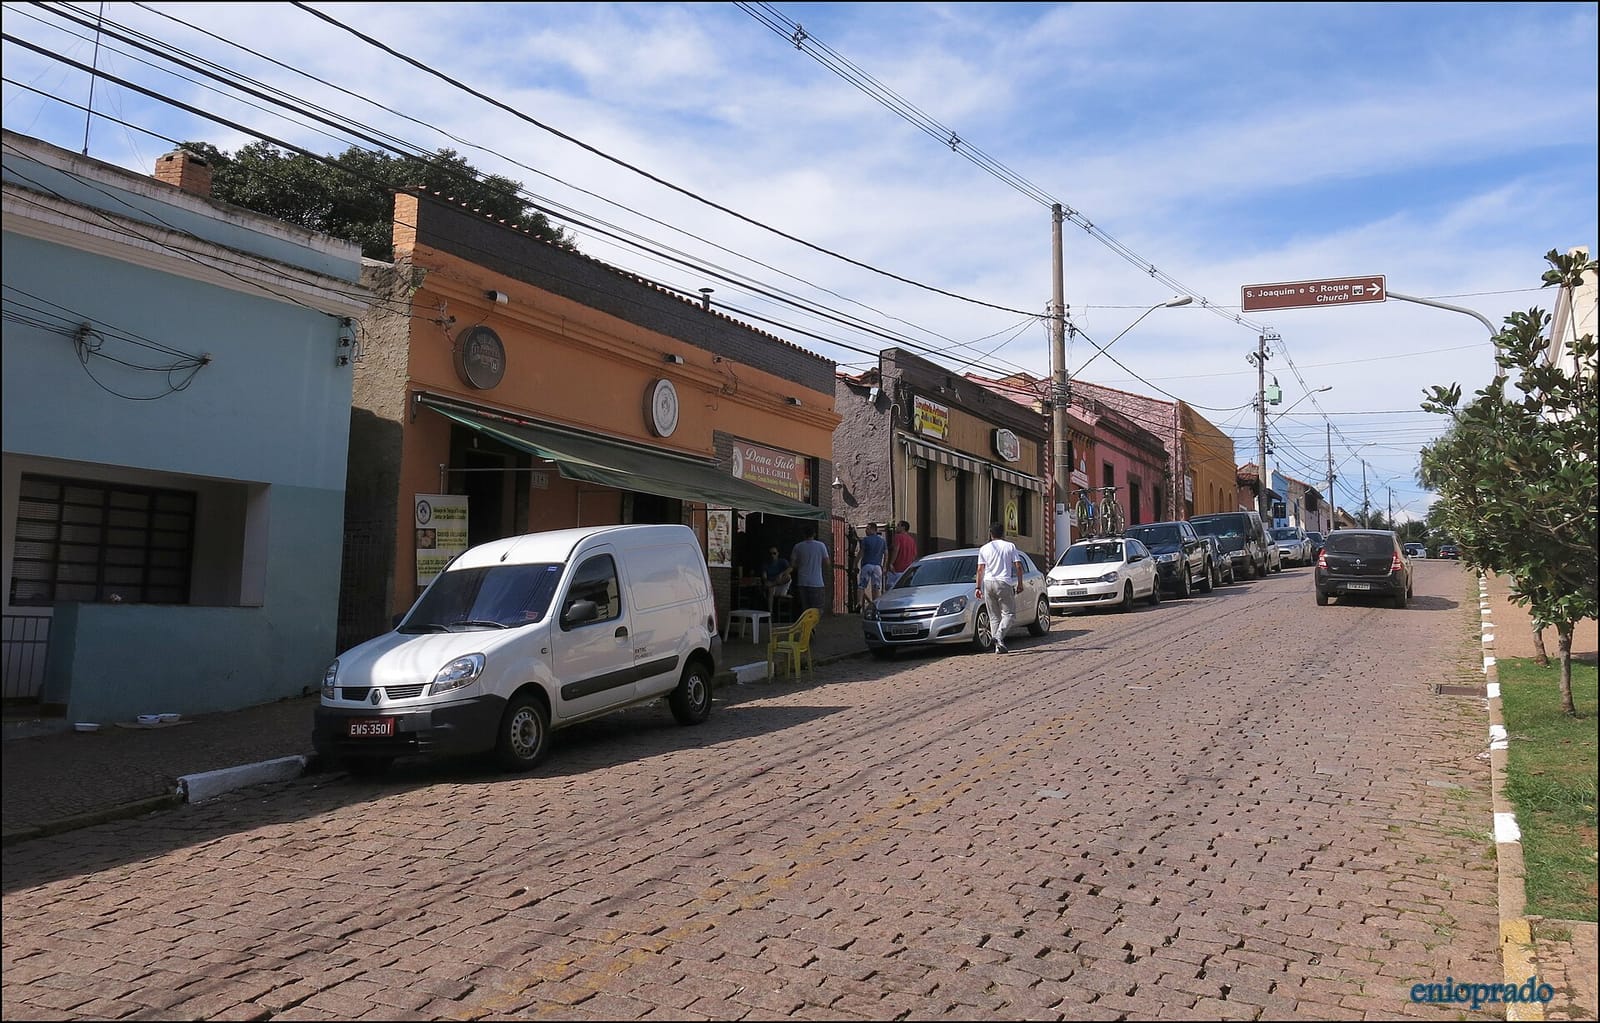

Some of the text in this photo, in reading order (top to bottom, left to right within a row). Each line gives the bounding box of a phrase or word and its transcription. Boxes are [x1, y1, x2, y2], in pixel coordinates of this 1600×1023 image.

[1246, 290, 1255, 298] S.
[1258, 288, 1295, 297] Joaquim
[1308, 285, 1318, 293] S.
[1320, 283, 1350, 292] Roque
[1316, 293, 1349, 302] Church
[744, 448, 772, 465] Dona
[750, 464, 765, 474] BAR
[771, 469, 793, 480] GRILL
